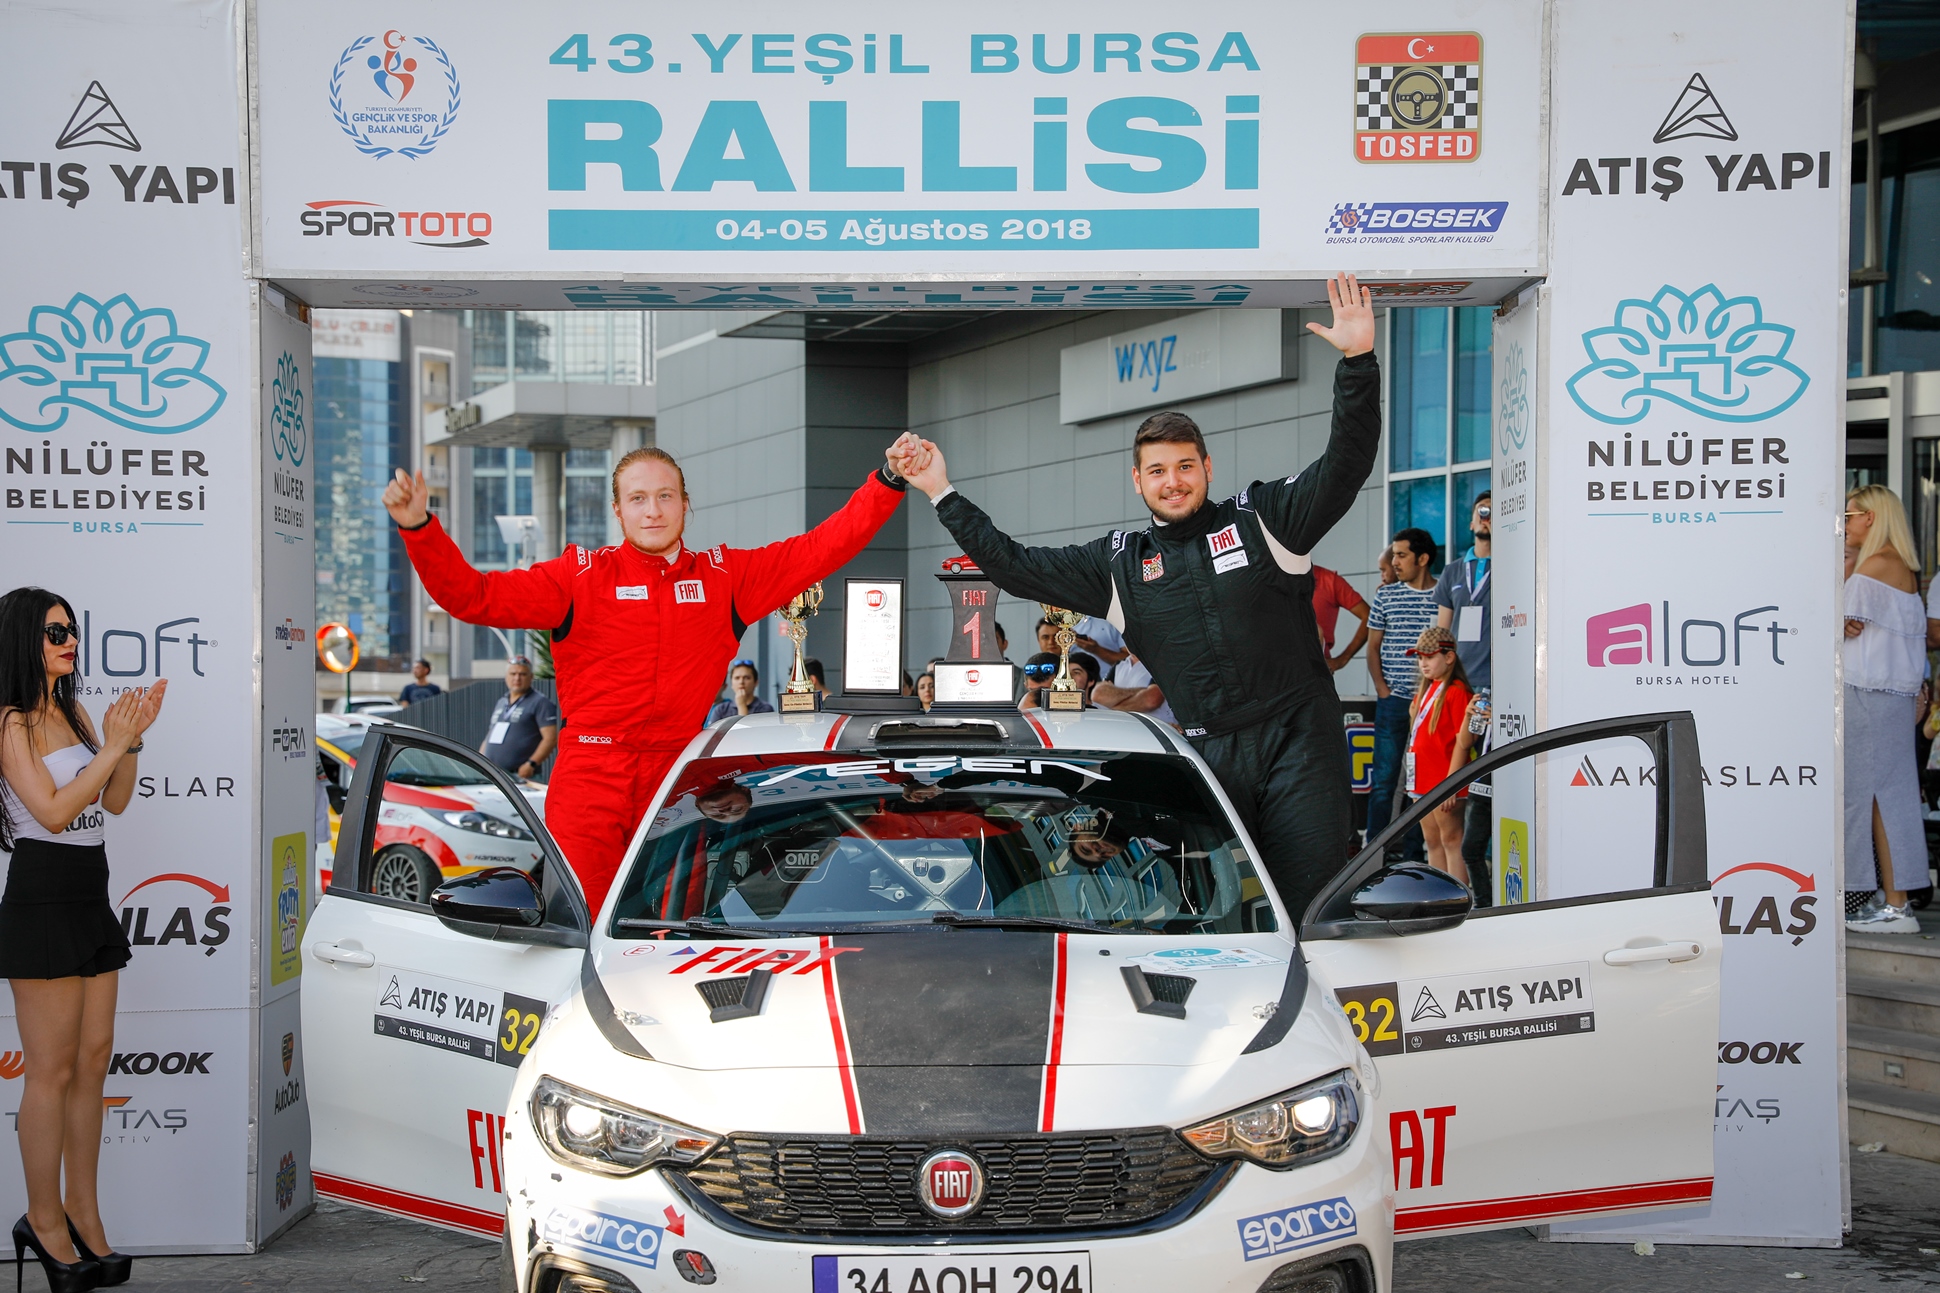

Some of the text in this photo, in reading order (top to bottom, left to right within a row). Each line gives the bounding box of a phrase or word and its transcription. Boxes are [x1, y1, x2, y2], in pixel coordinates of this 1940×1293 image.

[970, 31, 1261, 74] BURSA
[368, 124, 423, 134] BAKANLIĞI
[398, 114, 410, 122] VE
[412, 114, 438, 122] SPOR
[1361, 134, 1474, 158] TOSFED
[0, 161, 236, 209] TIŞ YAPI
[1562, 151, 1831, 201] ATIŞ YAPI
[715, 217, 1092, 246] 04-05 Ağustos 2018
[1367, 208, 1498, 228] BOSSEK
[1408, 236, 1454, 244] SPORLARI
[1455, 234, 1494, 243] KULÜBÜ
[6, 440, 209, 477] NİLÜFER
[1588, 431, 1789, 467] NİLÜFER
[274, 467, 305, 502] NİLÜFER
[1501, 459, 1527, 490] NİLÜFER
[1587, 472, 1786, 501] BELEDİYESİ
[6, 484, 206, 511] BELEDİYESİ
[73, 522, 138, 533] BURSA
[1652, 512, 1718, 524] BURSA
[1212, 528, 1236, 553] FIAT
[678, 583, 699, 600] FIAT
[962, 589, 987, 606] FIAT
[84, 610, 208, 678] loft
[963, 611, 981, 659] 1
[1586, 600, 1788, 668] aloft
[1636, 675, 1739, 685] BURSA HOTEL
[578, 735, 612, 744] sparco
[138, 777, 235, 799] ŞLAR
[1610, 765, 1818, 787] AKAŞLAR
[1065, 817, 1099, 833] OMP
[785, 852, 821, 868] OMP
[1712, 895, 1818, 947] LAŞ
[668, 947, 865, 975] FIAT
[1172, 949, 1204, 957] 32
[408, 987, 495, 1026] ATIŞ YAPI
[1454, 977, 1583, 1013] ATIŞ YAPI
[501, 1008, 540, 1056] 32
[1342, 997, 1398, 1044] 32
[398, 1026, 408, 1036] 43.
[426, 1031, 446, 1045] BURSA
[1445, 1033, 1460, 1044] 43.
[1489, 1027, 1521, 1039] BURSA
[108, 1052, 214, 1075] KOOK
[274, 1078, 300, 1115] AutoClub
[467, 1109, 505, 1194] FI
[1389, 1105, 1456, 1191] AT
[935, 1170, 970, 1198] FIAT
[545, 1206, 658, 1257] sparco
[1243, 1200, 1354, 1255] sparco
[847, 1267, 890, 1293] 34
[1012, 1264, 1083, 1293] 294
